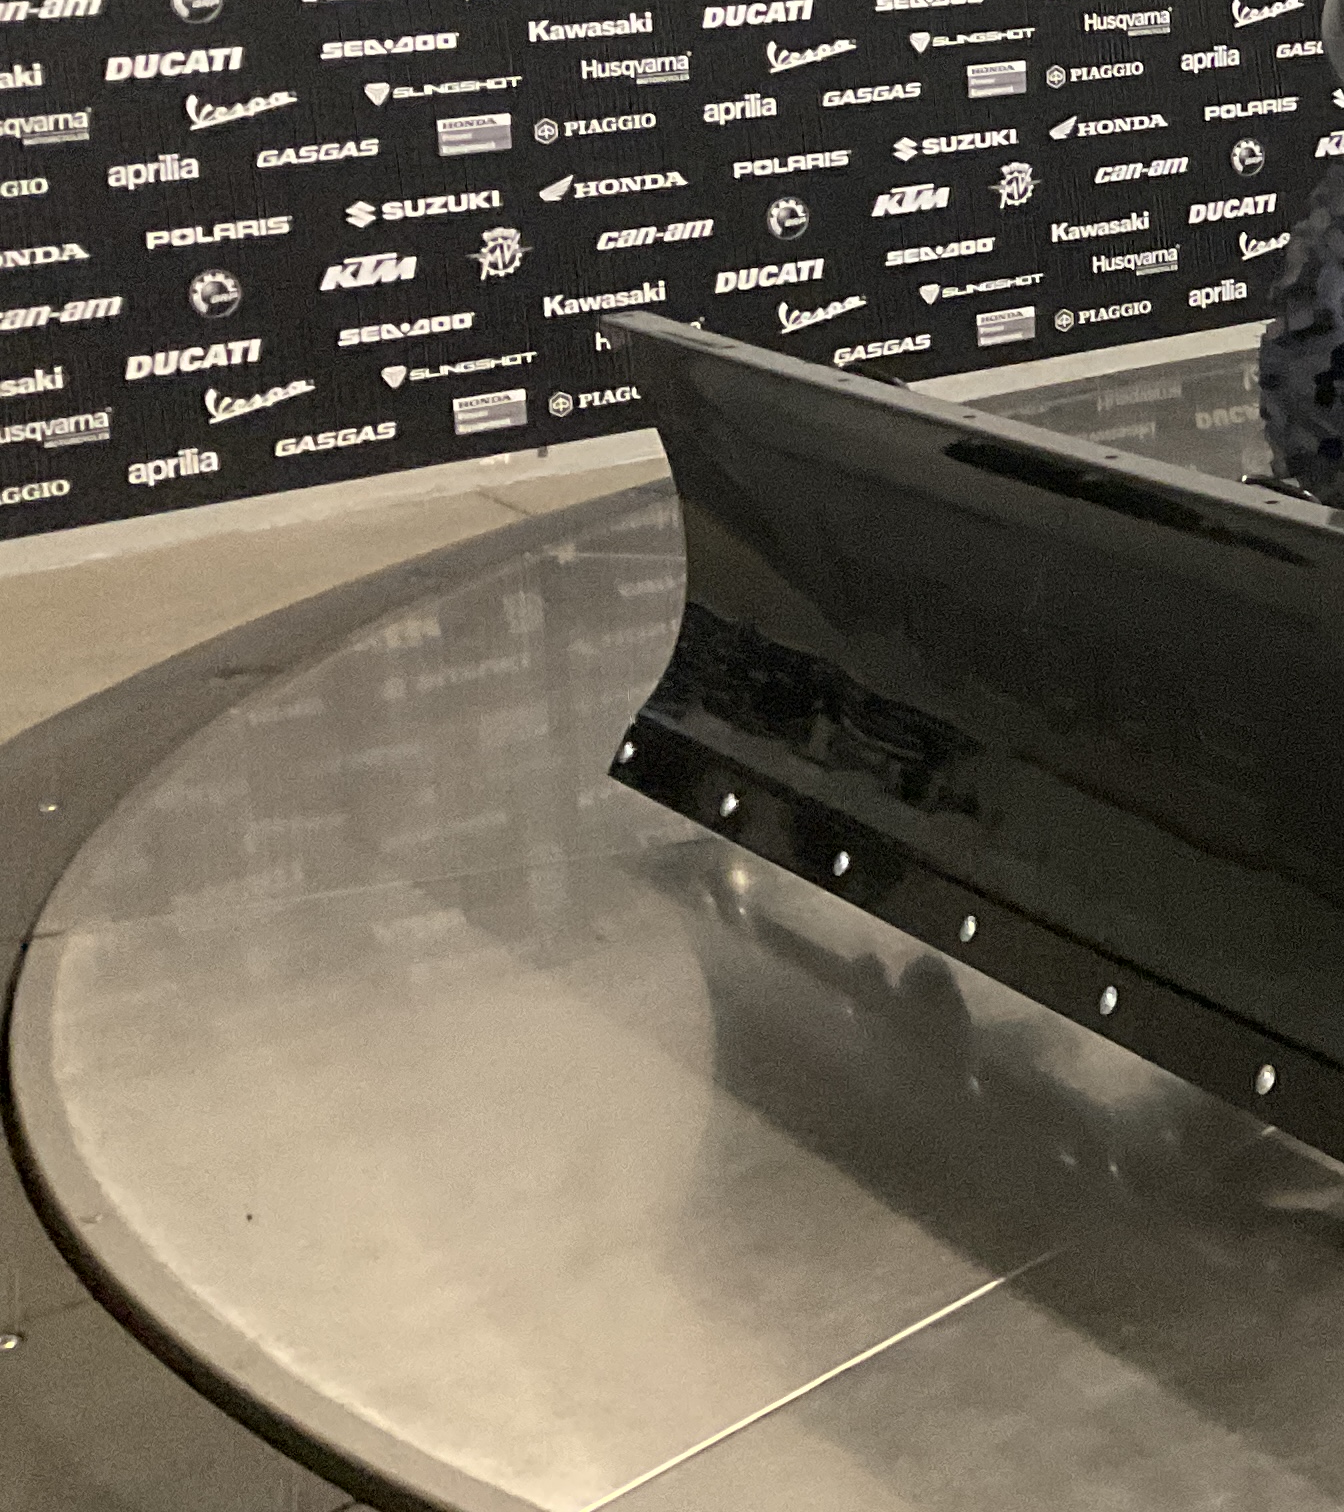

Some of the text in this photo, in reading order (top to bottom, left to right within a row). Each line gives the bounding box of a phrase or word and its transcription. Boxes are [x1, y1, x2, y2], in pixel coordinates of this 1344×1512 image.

[528, 12, 653, 42] Kawasaki
[702, 0, 813, 29] DUCATI
[1084, 8, 1168, 31] Husqvarna
[933, 28, 1035, 46] SLINGSHOT
[105, 47, 243, 81] DUCATI
[581, 53, 688, 79] Husqvarna
[767, 39, 856, 73] Vespa
[1181, 45, 1240, 73] aprilia
[1070, 62, 1143, 81] PIAGGIO
[393, 76, 522, 98] SLINGSHOT
[822, 82, 921, 107] GASGAS
[186, 91, 297, 131] Vespa
[703, 93, 777, 125] aprilia
[1204, 97, 1299, 121] POLARIS
[564, 113, 656, 136] PIAGGIO
[1080, 114, 1168, 136] HONDA
[257, 138, 379, 168] GASGAS
[922, 129, 1019, 154] SUZUKI
[108, 154, 199, 190] aprilia
[733, 150, 851, 178] POLARIS
[1094, 157, 1188, 183] can-am
[577, 172, 687, 198] HONDA
[871, 183, 950, 217] KTM
[382, 190, 502, 220] SUZUKI
[1189, 193, 1276, 224] DUCATI
[146, 216, 292, 249] POLARIS
[597, 219, 714, 250] can-am
[1051, 211, 1149, 242] Kawasaki
[320, 252, 417, 291] KTM
[1093, 246, 1176, 271] Husqvarna
[715, 258, 824, 293] DUCATI
[942, 273, 1043, 298] SLINGSHOT
[544, 280, 666, 317] Kawasaki
[1189, 279, 1247, 308] aprilia
[778, 296, 866, 334] Vespa
[1078, 301, 1151, 324] PIAGGIO
[125, 339, 262, 380] DUCATI
[833, 334, 931, 367] GASGAS
[410, 352, 537, 380] SLINGSHOT
[205, 380, 315, 424] Vespa
[275, 422, 397, 457] GASGAS
[129, 448, 219, 486] aprilia
